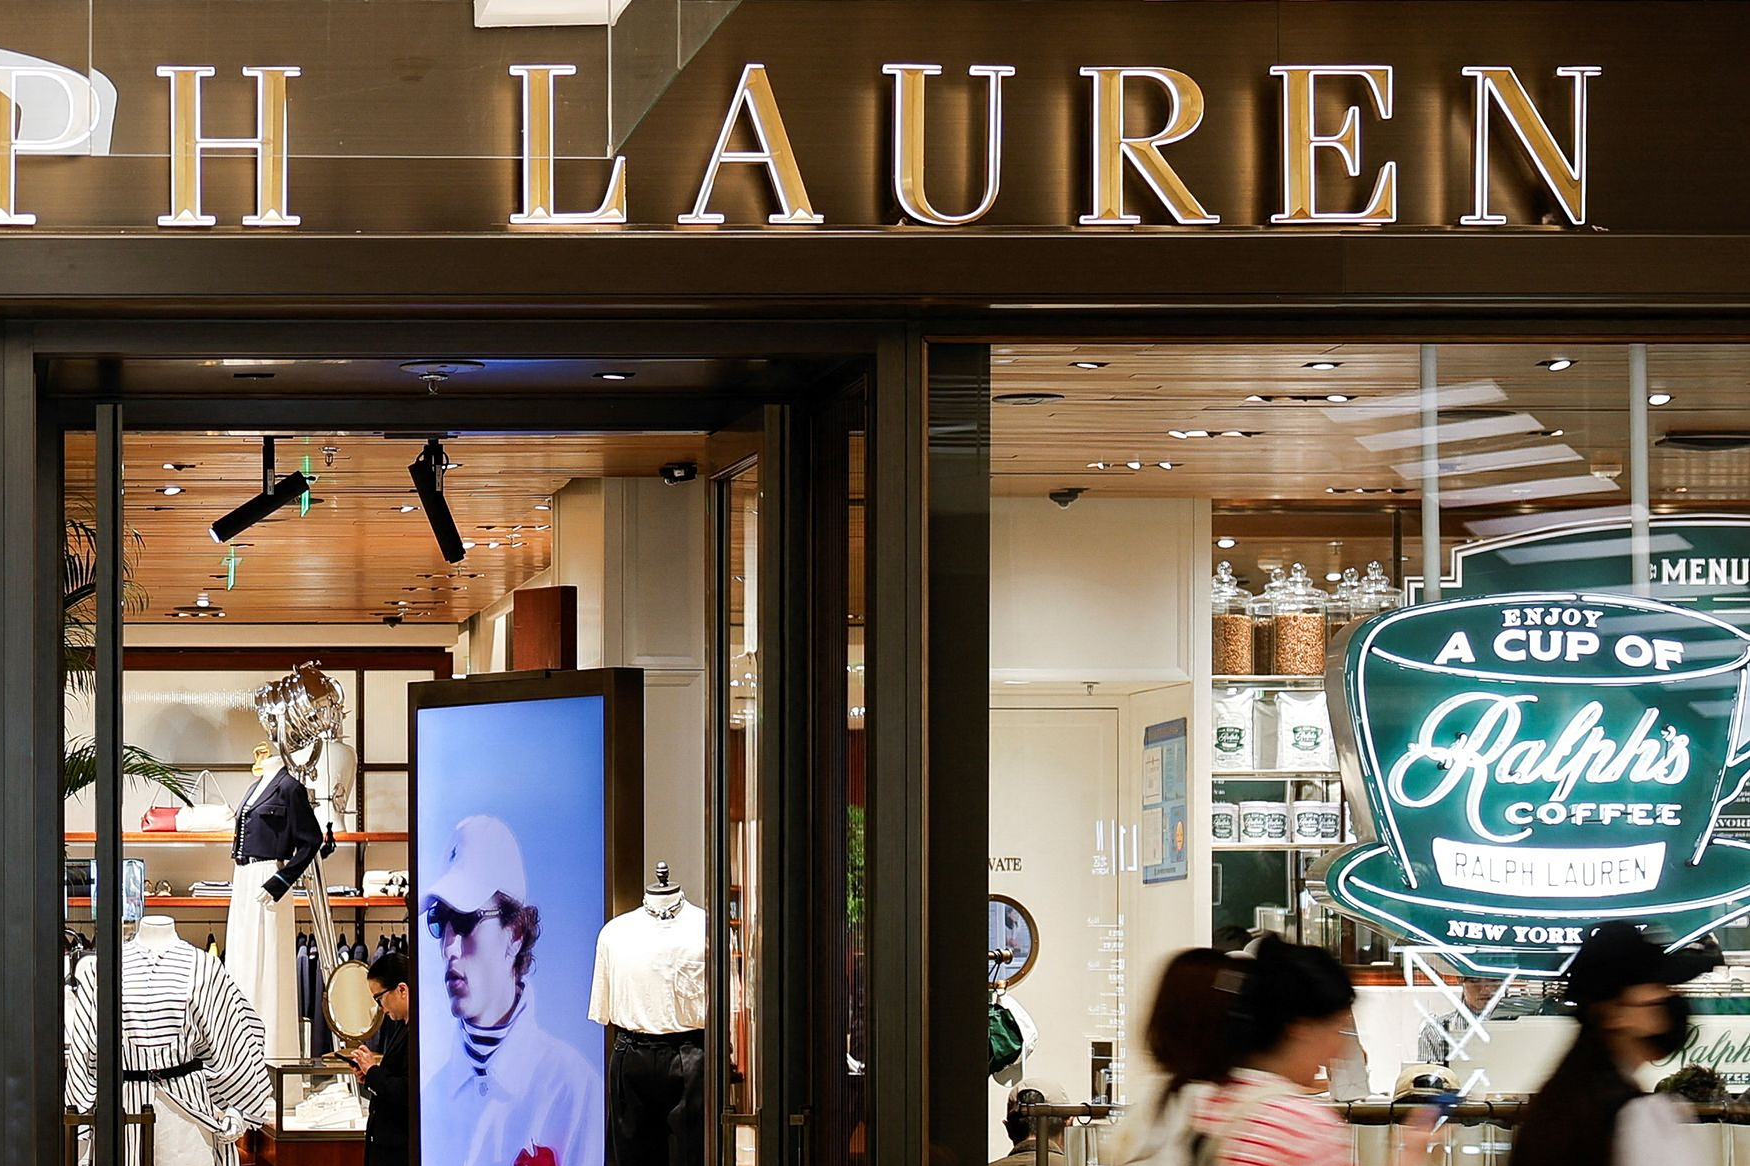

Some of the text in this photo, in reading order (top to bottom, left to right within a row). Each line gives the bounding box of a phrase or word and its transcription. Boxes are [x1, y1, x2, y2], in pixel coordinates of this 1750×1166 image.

[508, 63, 1601, 227] LAUREN
[1661, 558, 1749, 585] MENU
[1502, 608, 1603, 627] ENJOY
[1433, 629, 1685, 671] A CUP OF
[1388, 692, 1692, 843] Ralph's
[1504, 802, 1682, 826] COFFEE
[988, 857, 1022, 872] VATE
[1455, 852, 1647, 887] RALPH LAUREN
[1447, 920, 1508, 941] NEW
[1512, 926, 1584, 944] YORK
